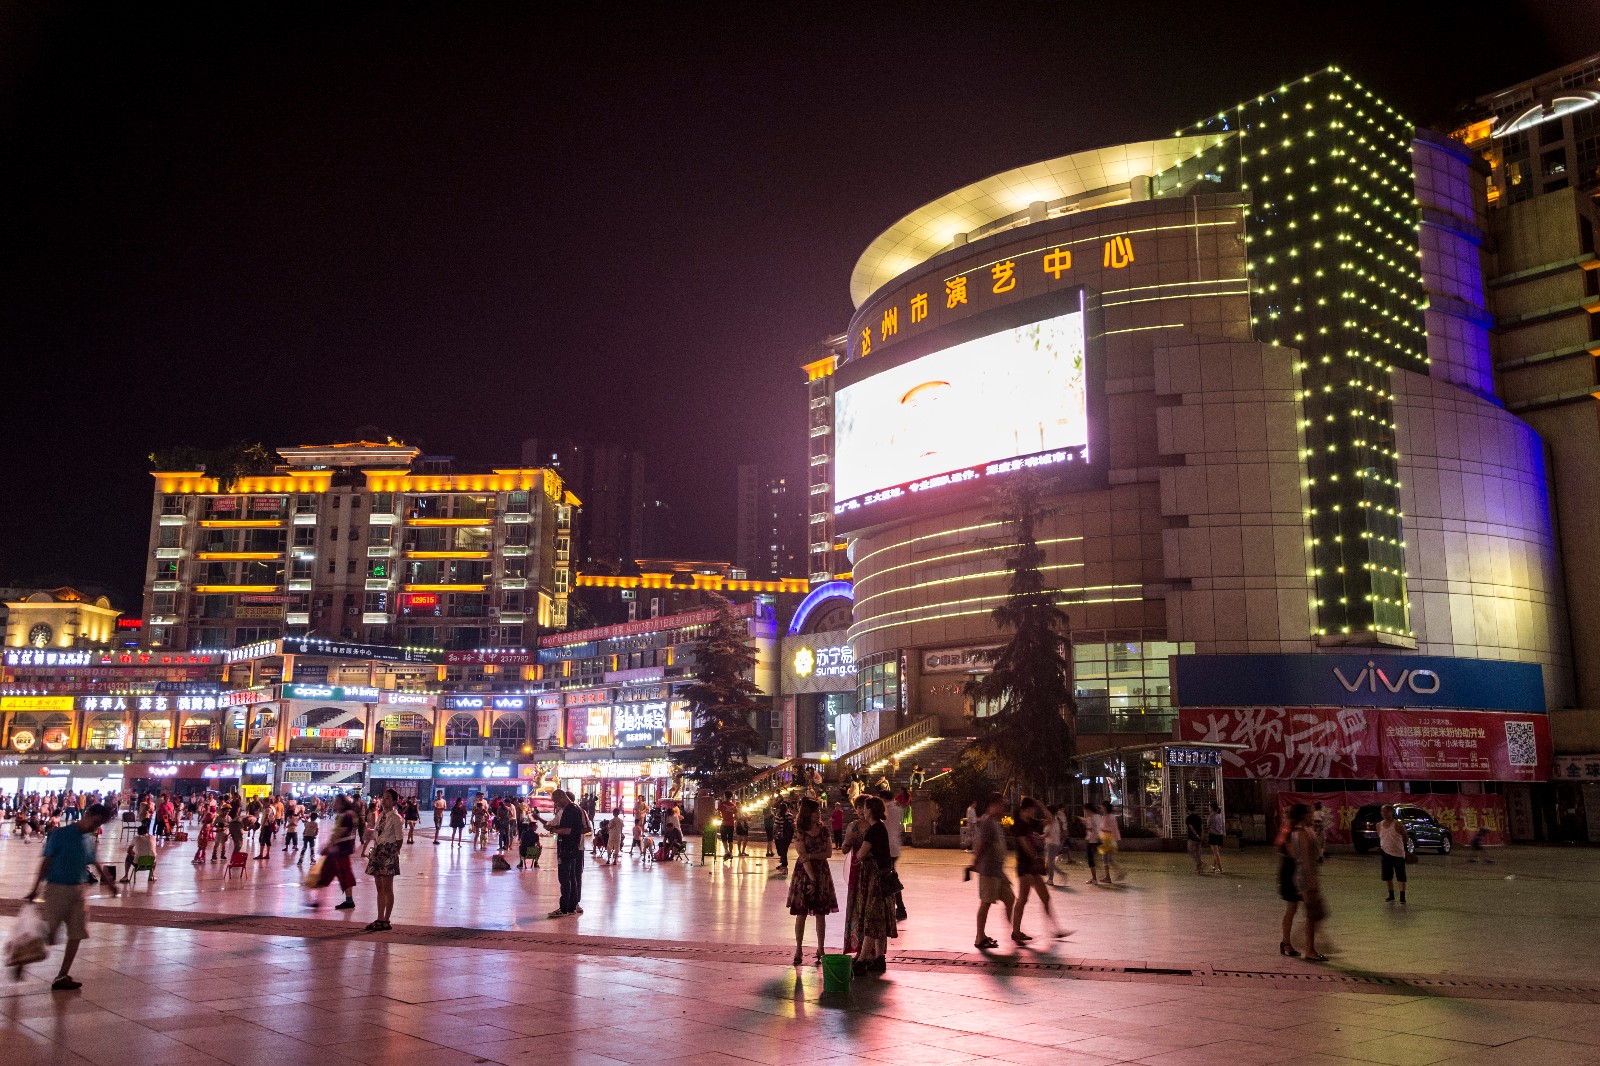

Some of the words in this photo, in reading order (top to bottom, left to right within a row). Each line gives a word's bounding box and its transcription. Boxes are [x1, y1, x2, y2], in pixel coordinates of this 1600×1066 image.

[861, 235, 1134, 357] 达州市演艺中心
[816, 645, 854, 666] 苏宁易
[1333, 660, 1440, 694] vivo
[294, 687, 332, 696] oppo
[456, 698, 483, 707] vivo
[496, 698, 523, 707] vivo
[1386, 725, 1486, 739] 全城招募资深米粉协助开业
[439, 768, 474, 776] oppo
